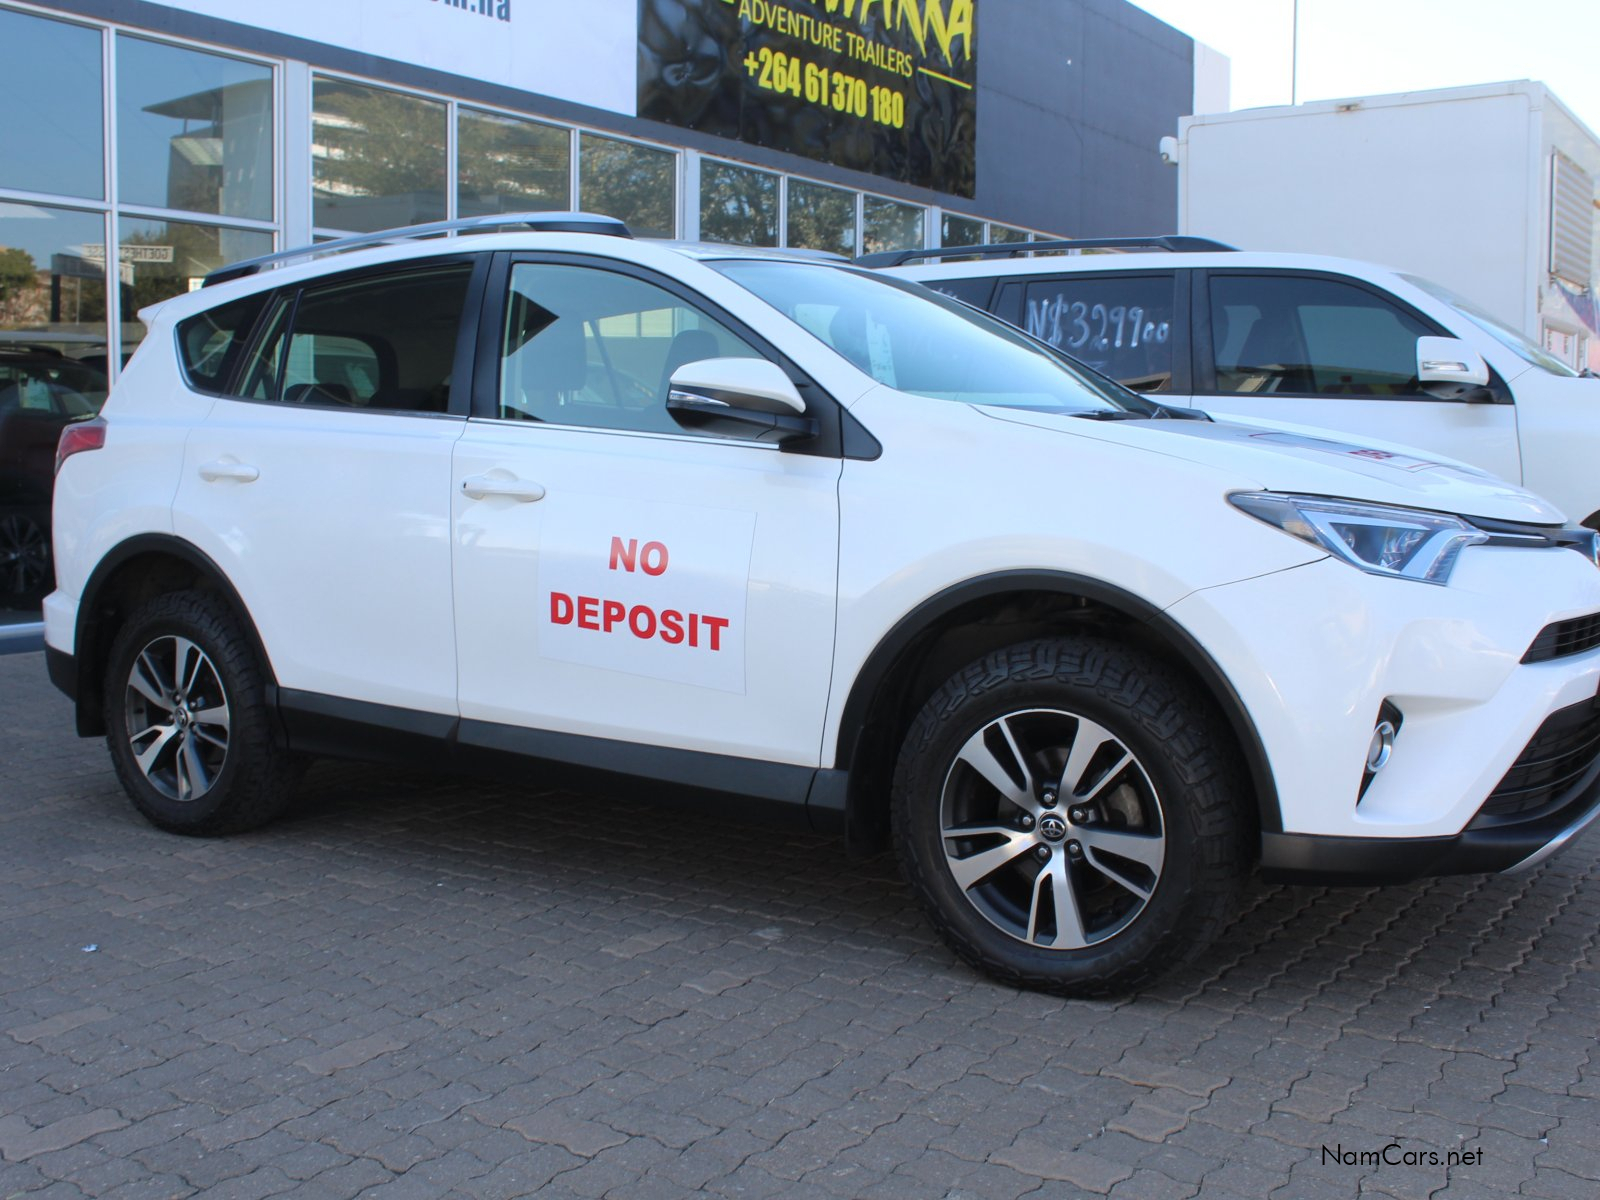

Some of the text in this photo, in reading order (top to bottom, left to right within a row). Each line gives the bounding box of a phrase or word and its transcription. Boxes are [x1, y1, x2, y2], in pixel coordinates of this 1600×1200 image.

[738, 0, 913, 78] ADVENTURE TRAILERS
[743, 47, 904, 129] +264 61 370 180
[609, 536, 669, 577] NO
[550, 591, 729, 651] DEPOSIT
